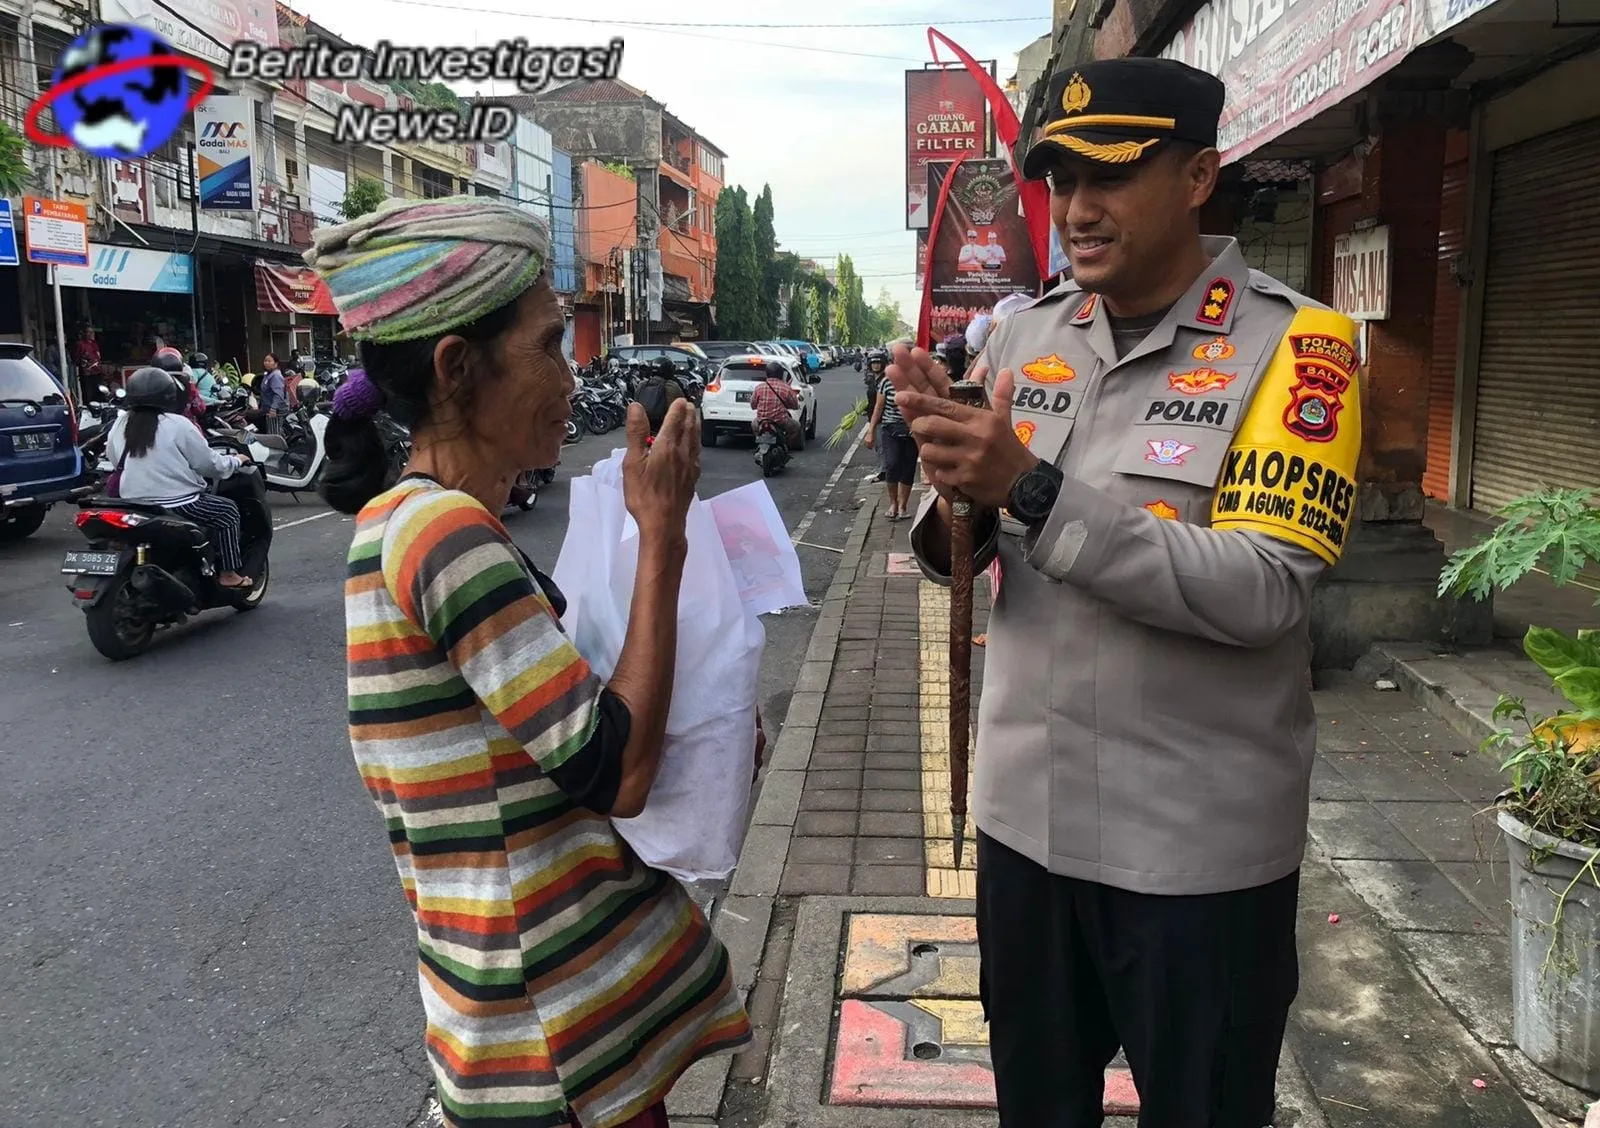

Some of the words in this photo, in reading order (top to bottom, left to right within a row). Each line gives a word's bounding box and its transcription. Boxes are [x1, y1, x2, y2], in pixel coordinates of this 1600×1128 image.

[153, 17, 174, 37] TOKO
[1290, 48, 1342, 113] GROSIR
[1355, 5, 1405, 73] ECER
[927, 113, 965, 121] GUDANG
[916, 121, 976, 134] GARAM
[199, 139, 226, 148] Gadai
[227, 140, 248, 148] MAS
[916, 138, 976, 150] FILTER
[92, 273, 117, 285] Gadai
[1301, 336, 1353, 362] POLRES
[1306, 366, 1339, 384] BALI
[1144, 399, 1229, 426] POLRI
[1222, 449, 1354, 521] KAOPSRES
[1217, 490, 1241, 514] OMB
[1245, 491, 1296, 521] AGUNG
